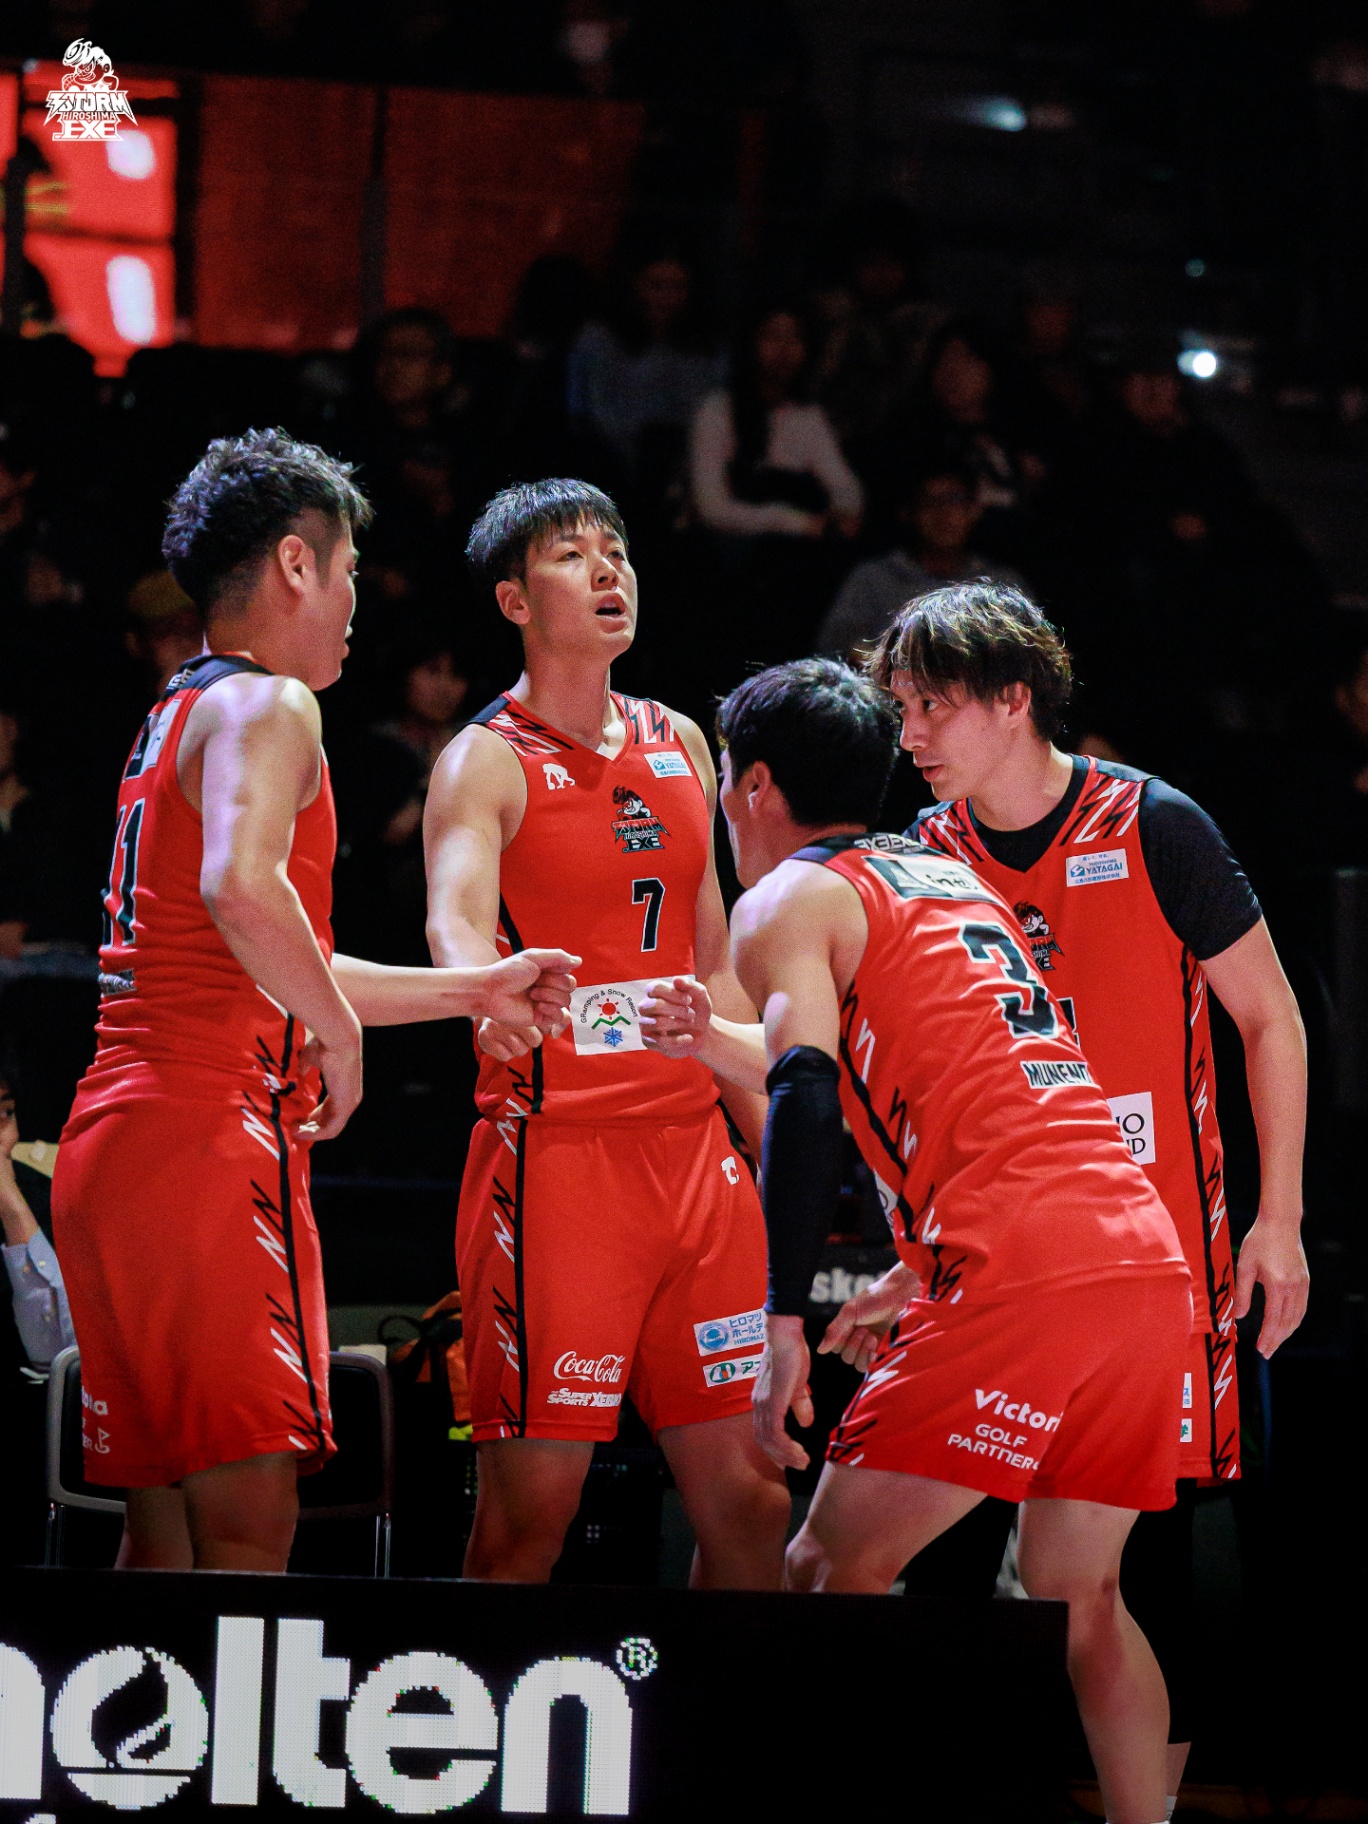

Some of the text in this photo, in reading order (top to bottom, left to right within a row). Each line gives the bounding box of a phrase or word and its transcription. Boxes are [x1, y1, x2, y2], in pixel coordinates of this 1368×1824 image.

[1086, 862, 1123, 874] YATAGAI
[632, 878, 665, 952] 7
[958, 921, 1059, 1039] 3
[607, 988, 626, 998] Snow
[729, 1313, 761, 1327] ヒロマツ
[547, 1393, 589, 1406] SPORTS
[975, 1423, 1027, 1447] GOLF
[947, 1434, 1034, 1469] PARTNER
